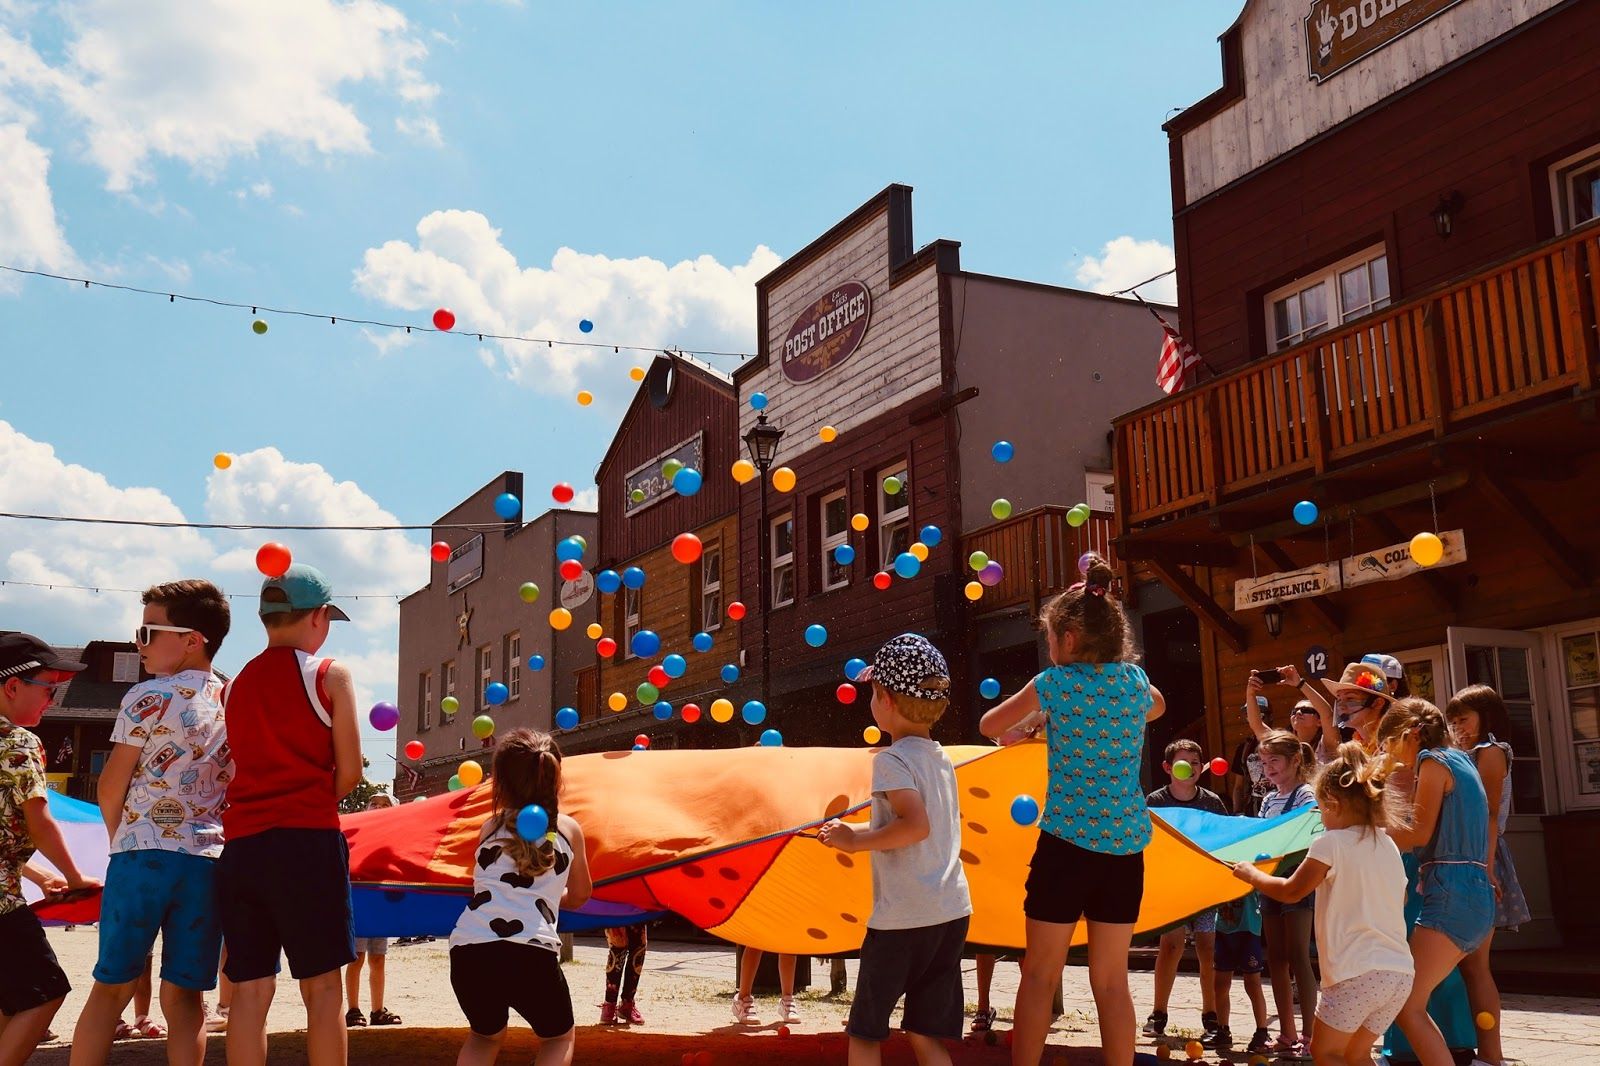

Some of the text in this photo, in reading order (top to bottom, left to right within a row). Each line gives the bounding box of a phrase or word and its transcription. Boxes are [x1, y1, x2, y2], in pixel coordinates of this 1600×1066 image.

[1340, 0, 1412, 41] DOL
[785, 291, 865, 363] POST OFFICE
[1384, 547, 1412, 564] COL
[1251, 579, 1320, 602] STRZELNICA
[1307, 652, 1327, 674] 12
